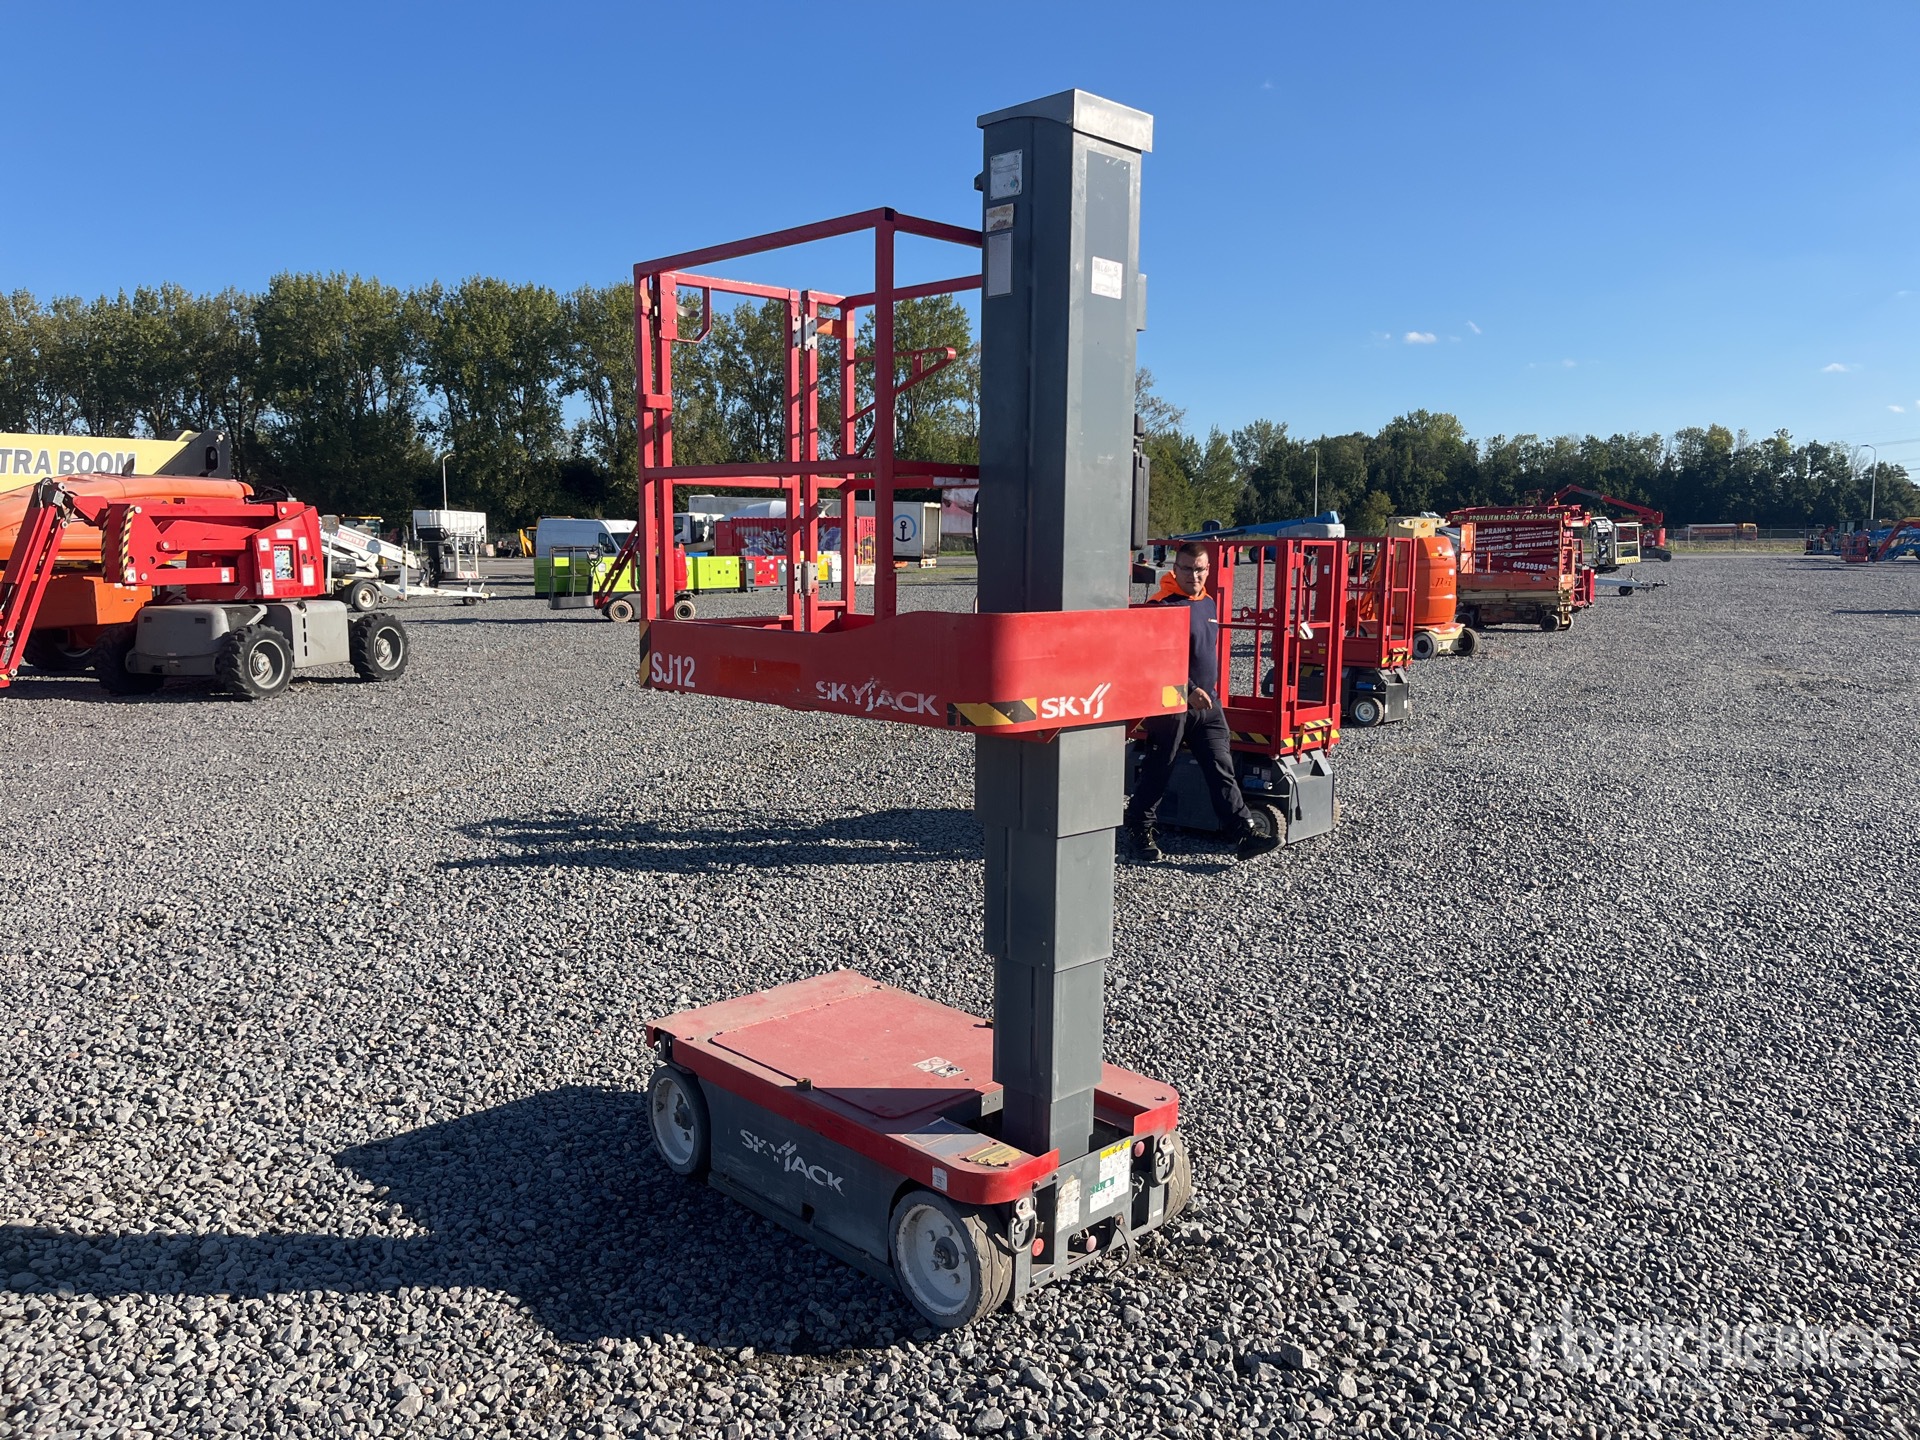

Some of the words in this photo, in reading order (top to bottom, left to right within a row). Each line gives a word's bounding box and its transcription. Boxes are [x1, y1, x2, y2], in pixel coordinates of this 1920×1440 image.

[58, 451, 135, 475] BOOM
[651, 652, 696, 688] SJ12
[815, 675, 940, 716] SKYJACK
